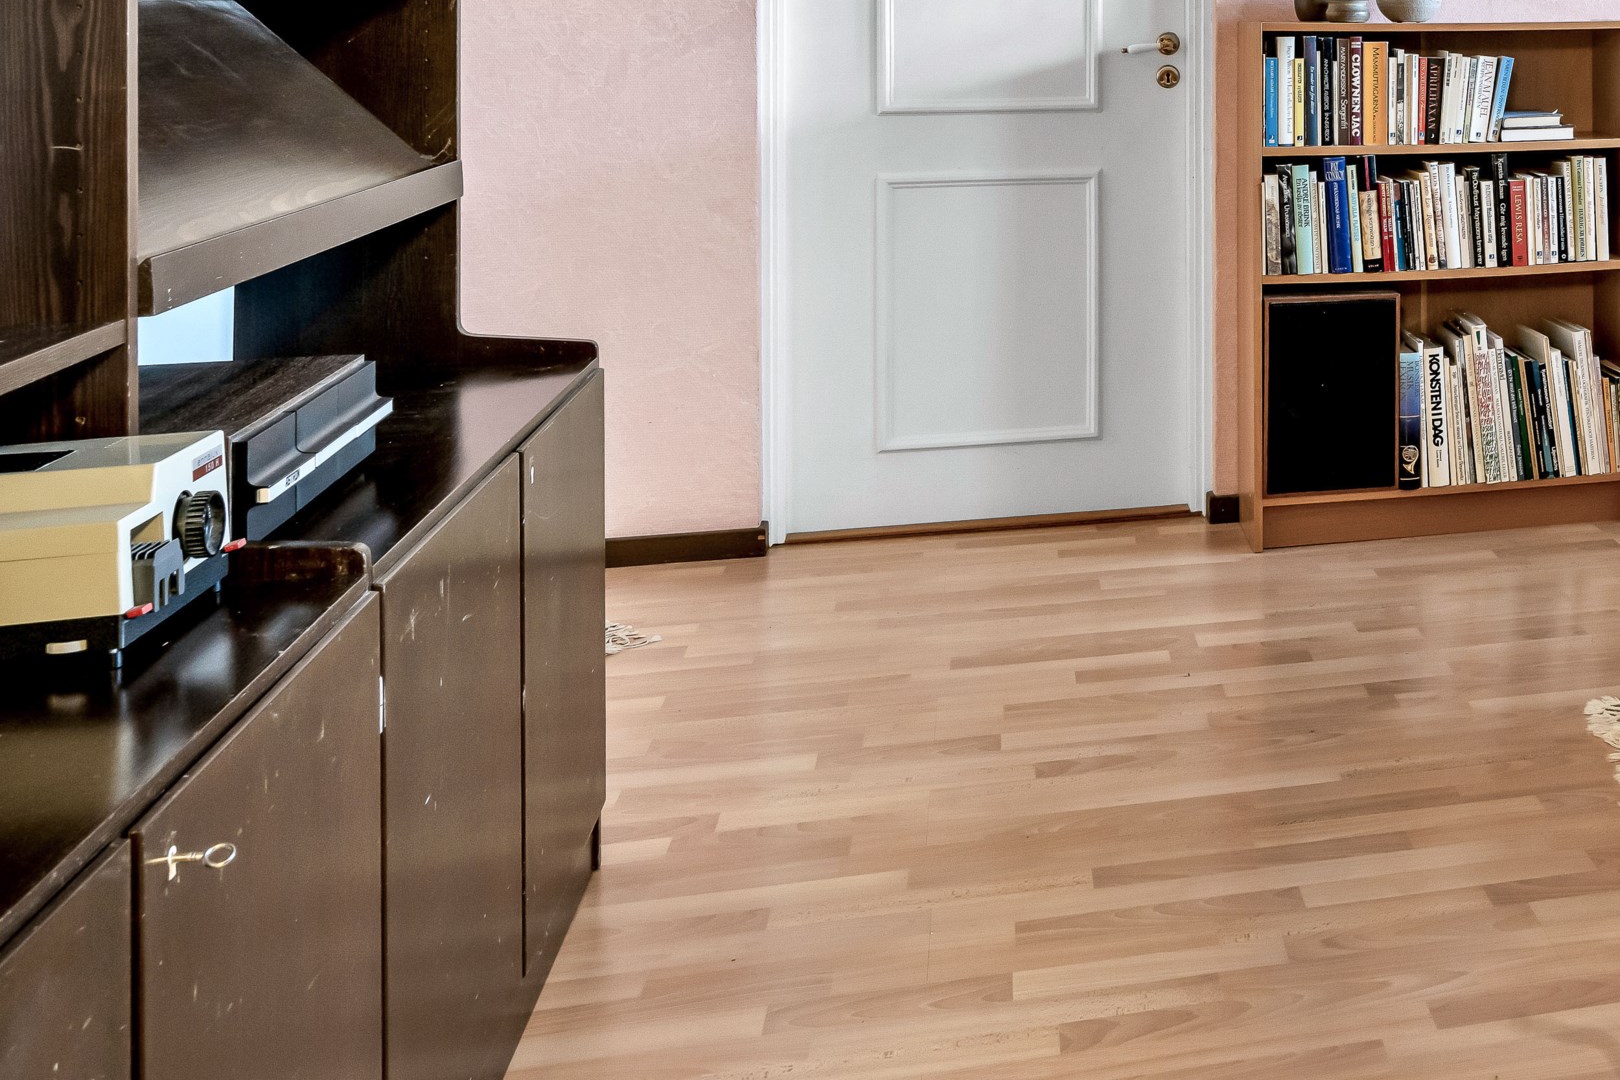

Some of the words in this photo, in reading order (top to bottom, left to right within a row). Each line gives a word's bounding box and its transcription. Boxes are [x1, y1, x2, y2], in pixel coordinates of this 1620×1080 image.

[1484, 59, 1495, 82] JEAN
[1352, 54, 1361, 113] CLOWNEN
[1428, 63, 1439, 130] APRILHÄXAN
[1480, 93, 1490, 119] AUEL
[1339, 99, 1348, 129] Sorgenfri
[1352, 115, 1361, 138] JAC
[1495, 158, 1505, 180] Kerstin
[1296, 178, 1302, 187] En
[1499, 180, 1508, 200] Ekman
[1514, 194, 1523, 220] LEWIS
[1499, 216, 1507, 227] mig
[1516, 222, 1524, 243] RESA
[1501, 227, 1509, 249] levande
[1407, 361, 1415, 391] MUSIK
[1428, 353, 1443, 413] KONSTEN
[1432, 419, 1445, 448] DAG
[205, 460, 215, 473] 150
